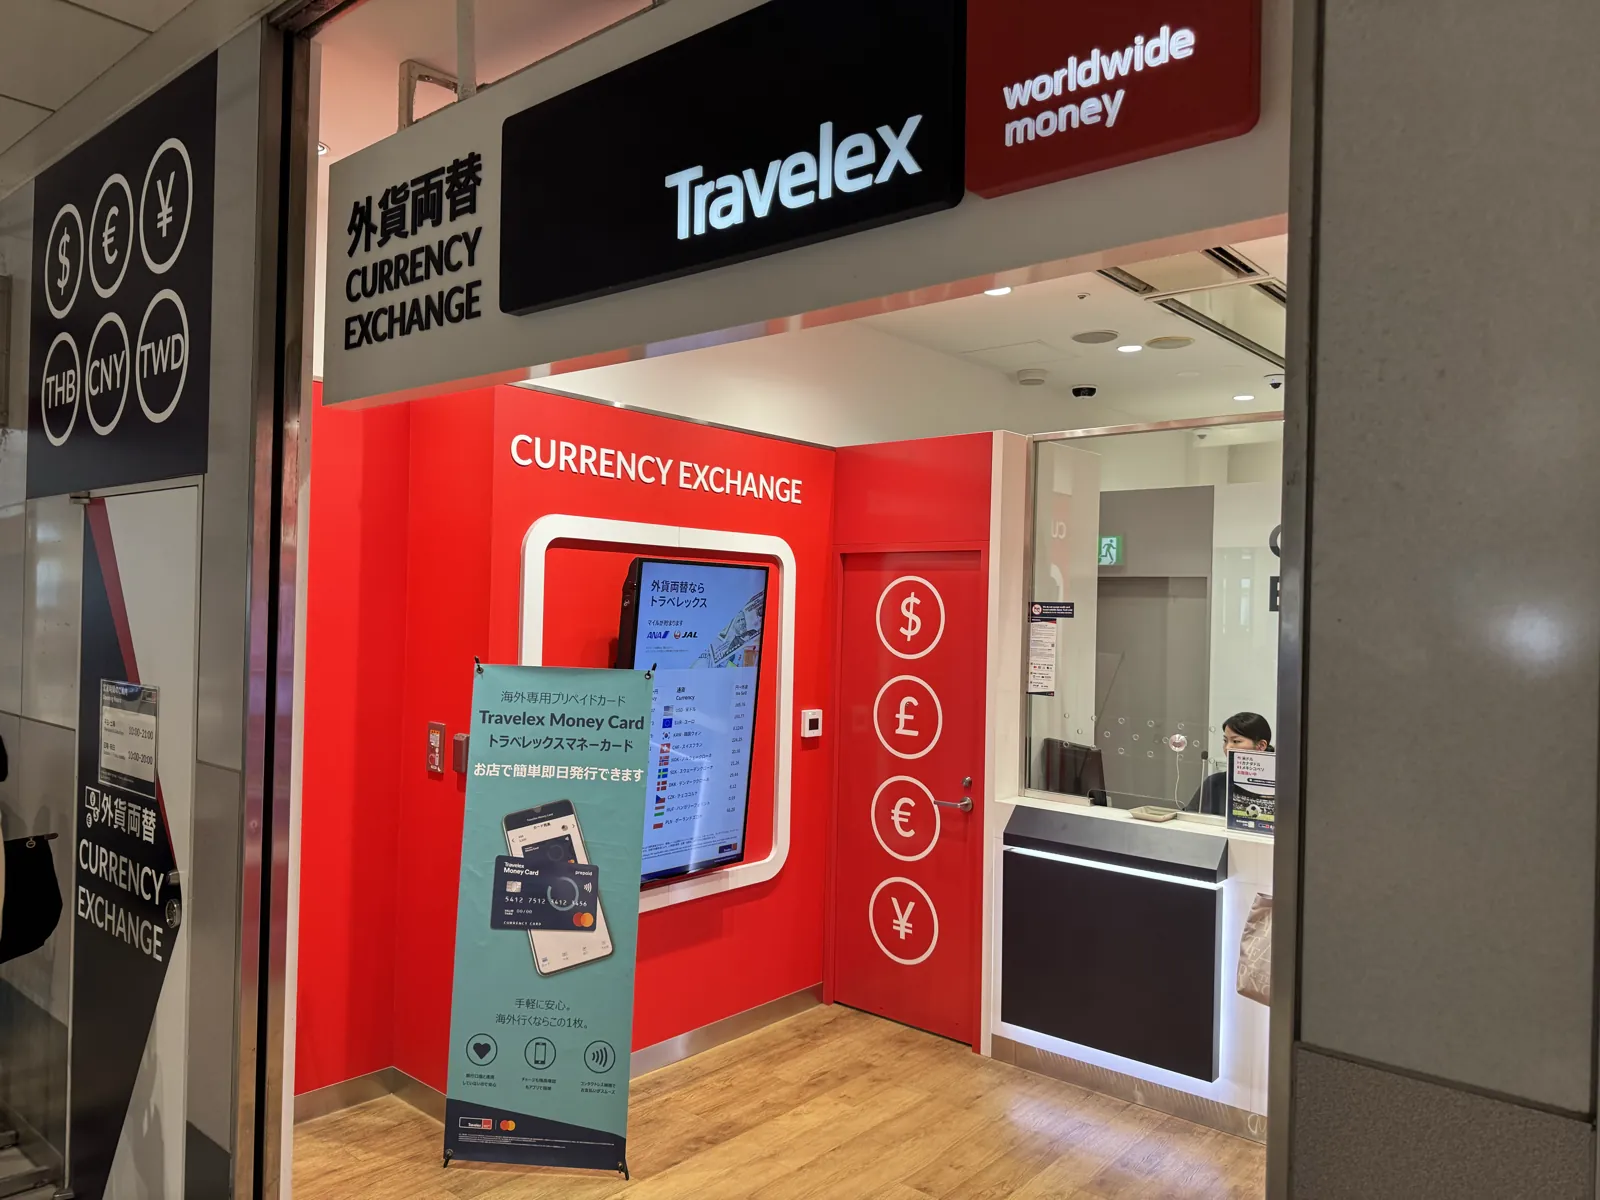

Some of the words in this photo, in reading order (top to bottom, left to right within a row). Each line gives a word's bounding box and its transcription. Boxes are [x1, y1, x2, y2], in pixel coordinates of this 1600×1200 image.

[1003, 24, 1195, 110] worldwide
[1003, 87, 1126, 147] money
[664, 114, 924, 240] Travelex
[346, 151, 483, 258] 外貨両替
[345, 227, 483, 303] CURRENCY
[344, 280, 482, 351] EXCHANGE
[46, 368, 76, 411] THB
[88, 349, 127, 396] CNY
[140, 333, 186, 379] TWD
[510, 434, 674, 486] CURRENCY
[679, 461, 802, 504] EXCHANGE
[651, 580, 705, 594] 外貨両替なら
[651, 595, 707, 608] トラベレックス
[500, 690, 626, 707] 海外専用プリペイドカード
[479, 710, 545, 727] Travelex
[550, 712, 604, 731] Money
[608, 716, 645, 730] Card
[489, 734, 633, 752] トラベレックスマネーカード
[128, 750, 153, 765] 10:00-20:00
[473, 762, 644, 782] お店で簡単即日発行できます
[101, 792, 157, 845] 外貨両替
[79, 838, 165, 905] CURRENCY
[503, 867, 525, 876] Money
[524, 868, 540, 876] Card
[504, 861, 525, 869] Travelex
[505, 896, 523, 904] 5412
[528, 897, 546, 905] 7512
[78, 885, 163, 962] EXCHANGE
[515, 998, 571, 1011] 手軽に安心。
[495, 1013, 588, 1030] 海外行くならこの1枚。
